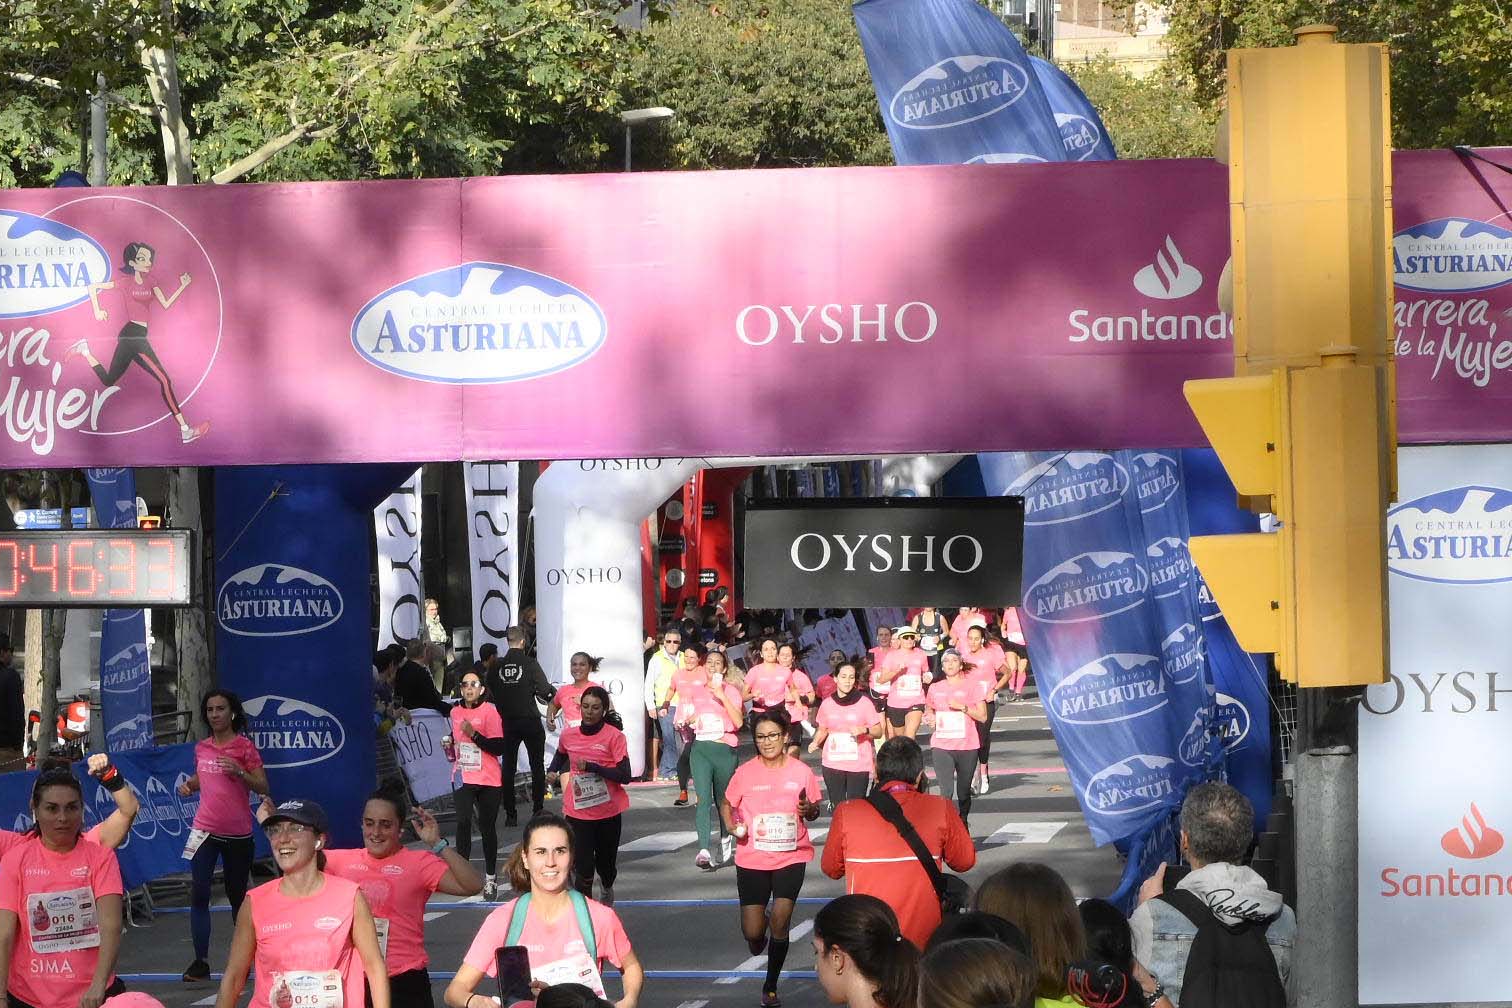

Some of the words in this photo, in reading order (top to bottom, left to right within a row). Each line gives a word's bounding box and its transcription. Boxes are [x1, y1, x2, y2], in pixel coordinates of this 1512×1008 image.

[13, 246, 89, 257] LECHERA
[410, 305, 488, 320] CENTRAL
[491, 303, 578, 319] LECHERA
[372, 310, 587, 354] ASTURIANA
[735, 301, 939, 346] OYSHO
[1069, 309, 1233, 342] Santand
[1417, 328, 1435, 355] la
[790, 532, 983, 574] OYSHO
[546, 566, 622, 586] OYSHO
[234, 588, 276, 597] CENTRAL
[281, 588, 329, 596] LECHERA
[222, 593, 334, 620] ASTURIANA
[505, 668, 517, 677] BP
[52, 914, 75, 925] 016
[295, 995, 319, 1004] 016
